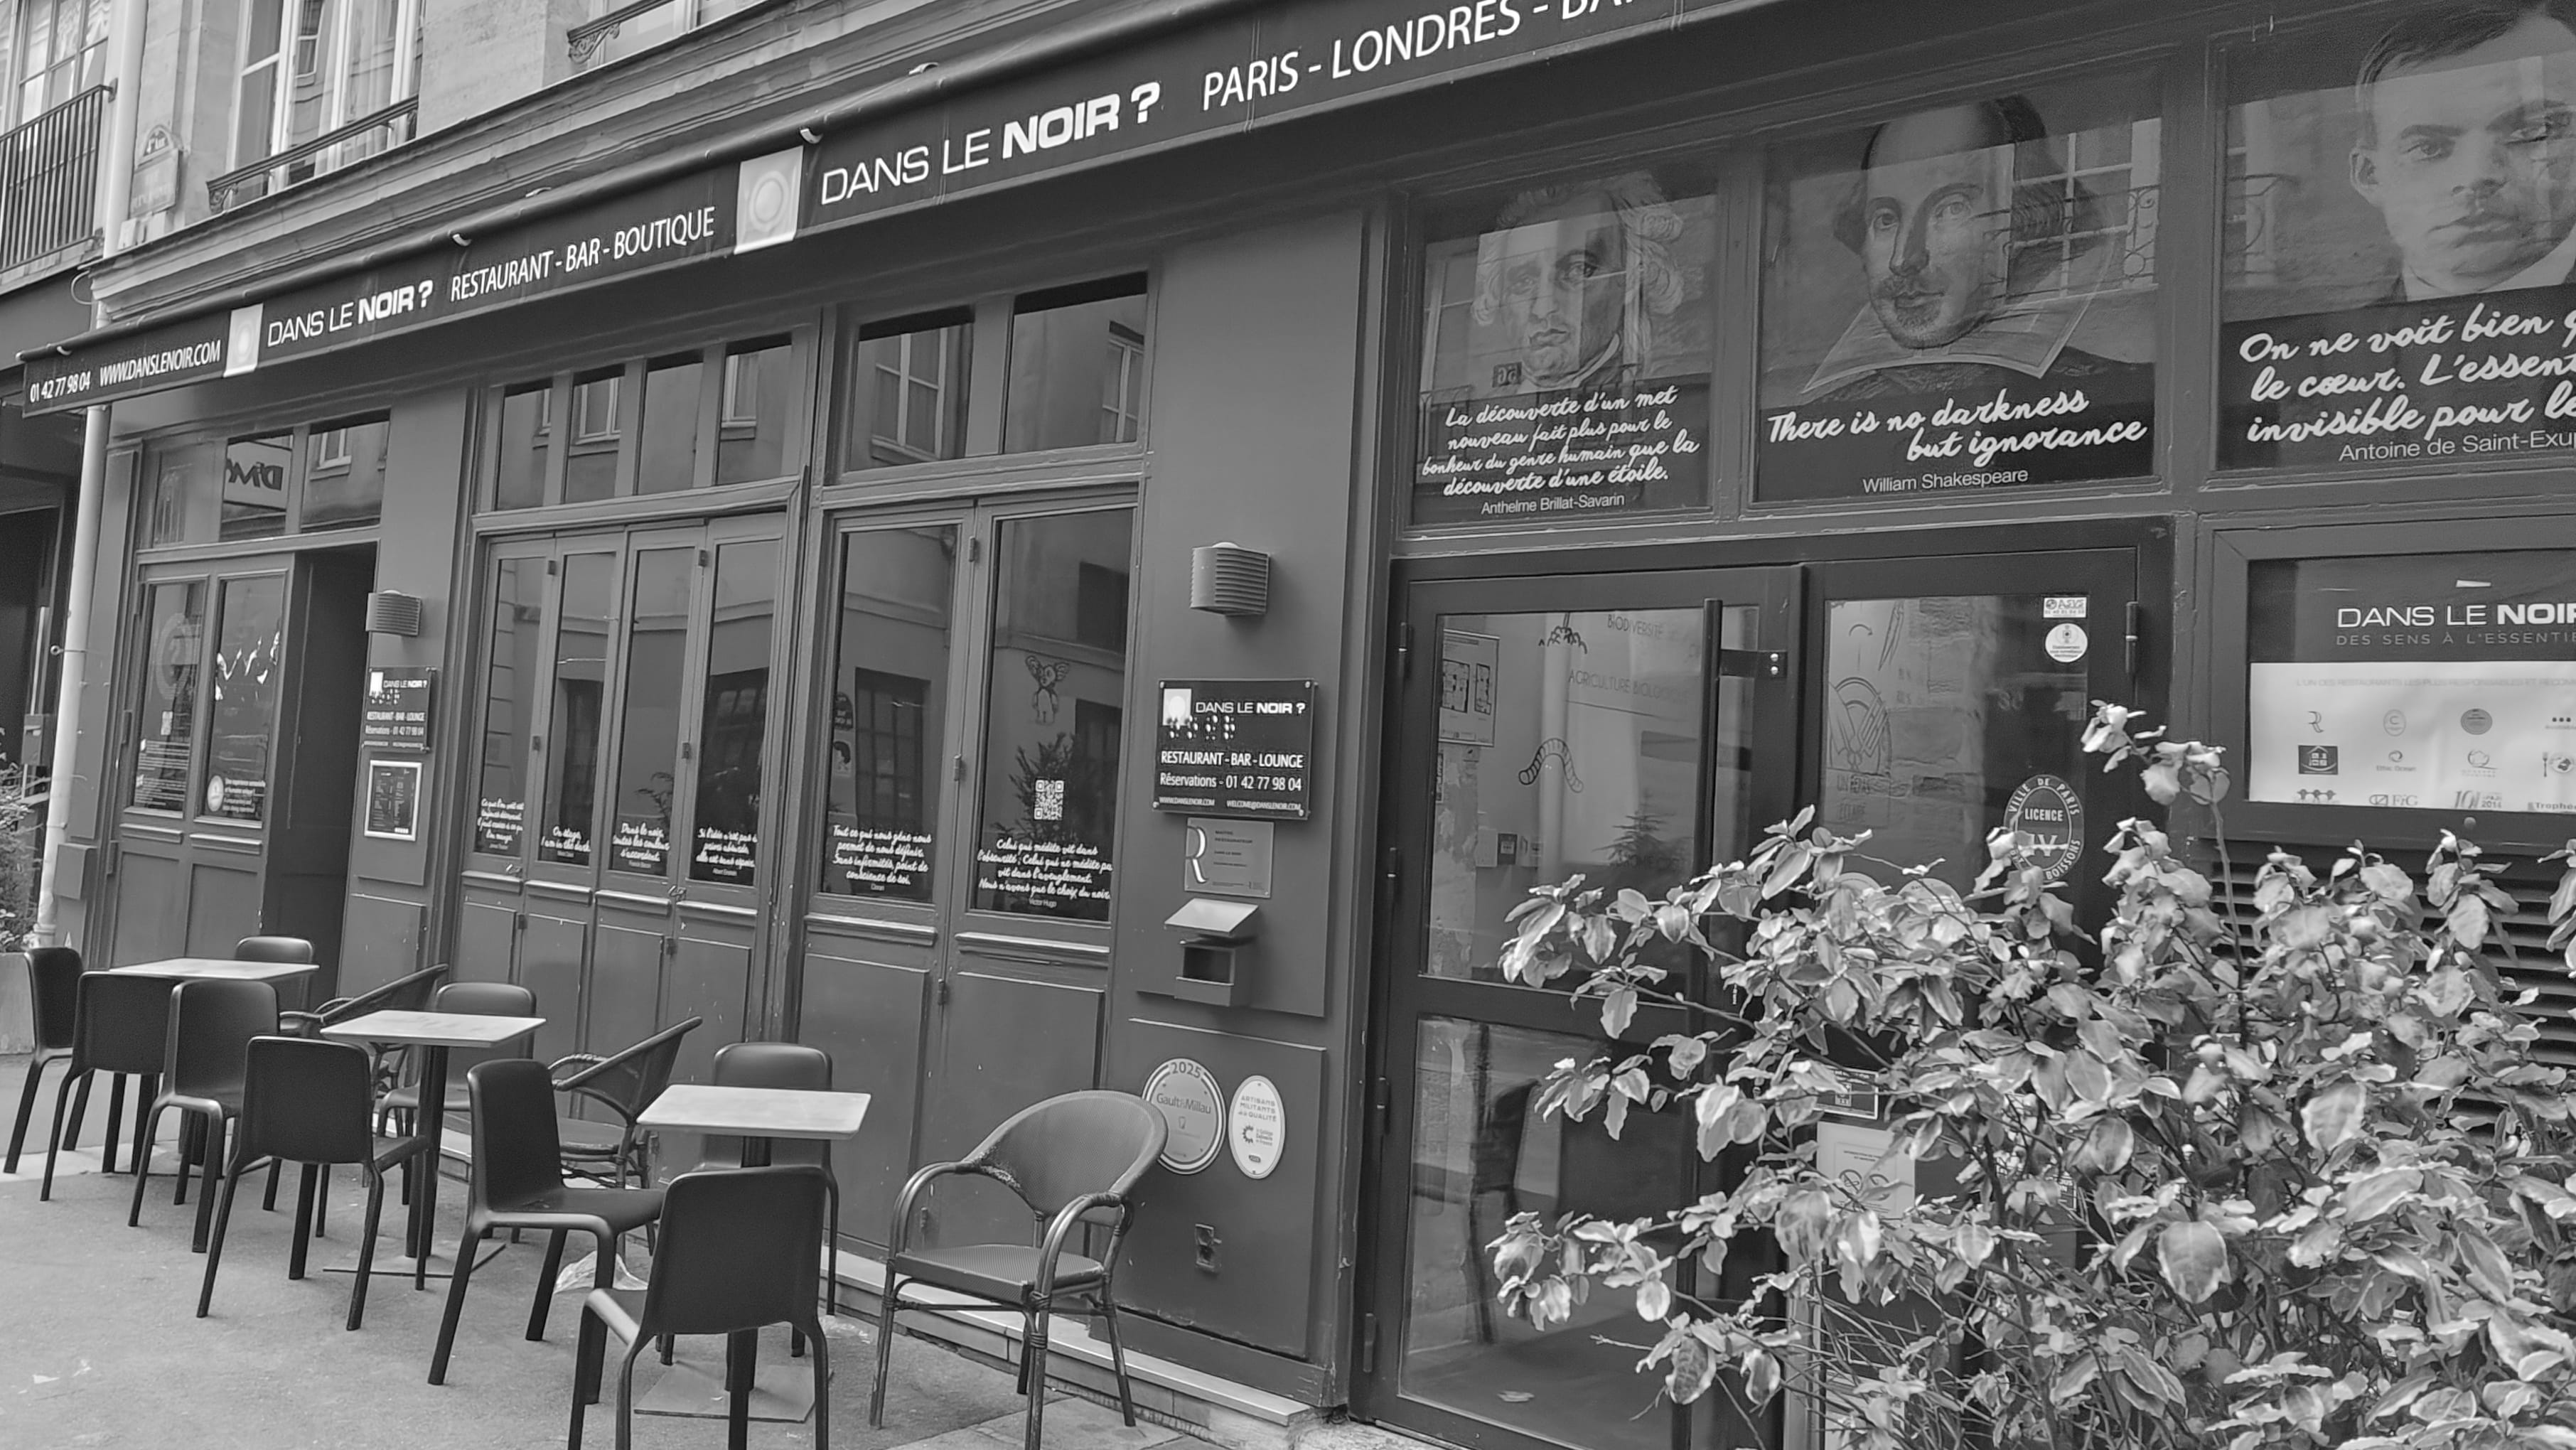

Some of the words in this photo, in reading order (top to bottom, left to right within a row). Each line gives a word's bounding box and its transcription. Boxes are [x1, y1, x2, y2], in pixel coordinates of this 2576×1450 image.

[1203, 50, 1299, 111] PARIS
[1332, 0, 1520, 79] LONDRES
[820, 144, 930, 205] DANS
[940, 129, 992, 177] LE
[1001, 92, 1121, 160] NOIR
[1130, 81, 1161, 124] ?
[451, 250, 554, 302] RESTAURANT
[566, 238, 601, 273] BAR
[614, 206, 715, 260] BOUTIQUE
[267, 318, 324, 348] DANS
[328, 303, 353, 333] LE
[357, 288, 416, 325] NOIR
[419, 280, 433, 308] ?
[2240, 333, 2299, 362] On
[2309, 332, 2360, 356] ne
[2367, 315, 2456, 353] voit
[2461, 302, 2554, 343] bien
[30, 382, 40, 403] 01
[41, 380, 54, 399] 42
[54, 377, 67, 397] 77
[68, 375, 78, 394] 98
[79, 370, 91, 391] 04
[100, 339, 221, 387] WWW.DANSLENOIR.COM
[2250, 365, 2290, 402] le
[1445, 407, 1472, 428] La
[1476, 397, 1580, 424] découverte
[1584, 392, 1629, 412] d'un
[1636, 385, 1678, 408] met
[1768, 412, 1845, 443] There
[1850, 412, 1880, 436] is
[1886, 413, 1926, 432] no
[1931, 388, 2089, 426] darkness
[2247, 394, 2425, 442] invisible
[2424, 398, 2535, 441] pour
[1447, 431, 1528, 450] nouveau
[1528, 424, 1566, 453] fait
[1567, 417, 1605, 446] plus
[1606, 419, 1650, 441] pour
[1653, 409, 1673, 430] le
[1422, 456, 1482, 476] bonheur
[1485, 451, 1506, 470] du
[1506, 453, 1555, 476] genre
[1557, 444, 1625, 464] humain
[1628, 440, 1668, 468] que
[1673, 428, 1700, 453] la
[1906, 428, 1963, 461] but
[1968, 419, 2148, 468] ignorance
[2339, 444, 2420, 461] Antoine
[2427, 437, 2456, 456] de
[2462, 430, 2576, 453] Saint-Exu
[1444, 474, 1545, 497] découverte
[1548, 466, 1603, 489] d'une
[1608, 456, 1669, 483] étoile.
[1863, 476, 1917, 493] William
[1922, 469, 2029, 491] Shakespeare
[1481, 498, 1537, 515] Anthelme
[1540, 493, 1625, 511] Brillat-Savarin
[2337, 606, 2435, 628] DANS
[2447, 605, 2487, 625] LE
[2336, 635, 2371, 646] DES
[2383, 634, 2431, 645] SENS
[2443, 631, 2454, 644] À
[1196, 702, 1234, 713] DANS
[1237, 702, 1254, 714] LE
[1257, 703, 1292, 714] NOIR
[1296, 703, 1306, 714] ?
[1161, 751, 1224, 766] RESTAURANT
[1231, 753, 1252, 766] BAR
[1259, 754, 1303, 768] LOUNGE
[1160, 773, 1216, 788] Réservations
[1226, 775, 1237, 788] 01
[1241, 776, 1253, 789] 42
[1257, 776, 1270, 790] 77
[1272, 778, 1285, 790] 98
[1288, 778, 1302, 790] 04
[2008, 783, 2031, 812] VILLE
[2037, 778, 2050, 786] DE
[2056, 783, 2080, 815] PARIS
[2025, 808, 2064, 822] LICENCE
[833, 825, 849, 837] Tout
[849, 829, 859, 837] ce
[858, 828, 873, 843] qui
[874, 830, 892, 840] nous
[912, 834, 931, 844] nous
[865, 841, 875, 853] de
[876, 845, 894, 854] nous
[997, 837, 1017, 850] Celui
[1018, 842, 1032, 855] qui
[1034, 842, 1061, 853] médite
[1062, 844, 1075, 854] vit
[1075, 843, 1098, 856] dans
[918, 860, 928, 873] de
[1022, 853, 1044, 866] Celui
[1045, 857, 1059, 871] qui
[1072, 858, 1100, 870] médite
[2046, 839, 2081, 880] BOISSONS
[886, 871, 896, 883] de
[997, 866, 1010, 878] vit
[1011, 866, 1031, 879] dans
[978, 878, 997, 889] Nous
[1030, 885, 1046, 898] que
[1046, 881, 1056, 894] le
[1056, 884, 1078, 900] choix
[1078, 886, 1090, 897] du
[1171, 1061, 1202, 1079] 2025
[1240, 1102, 1276, 1114] MILITANTS
[1241, 1095, 1275, 1107] ARTISANS
